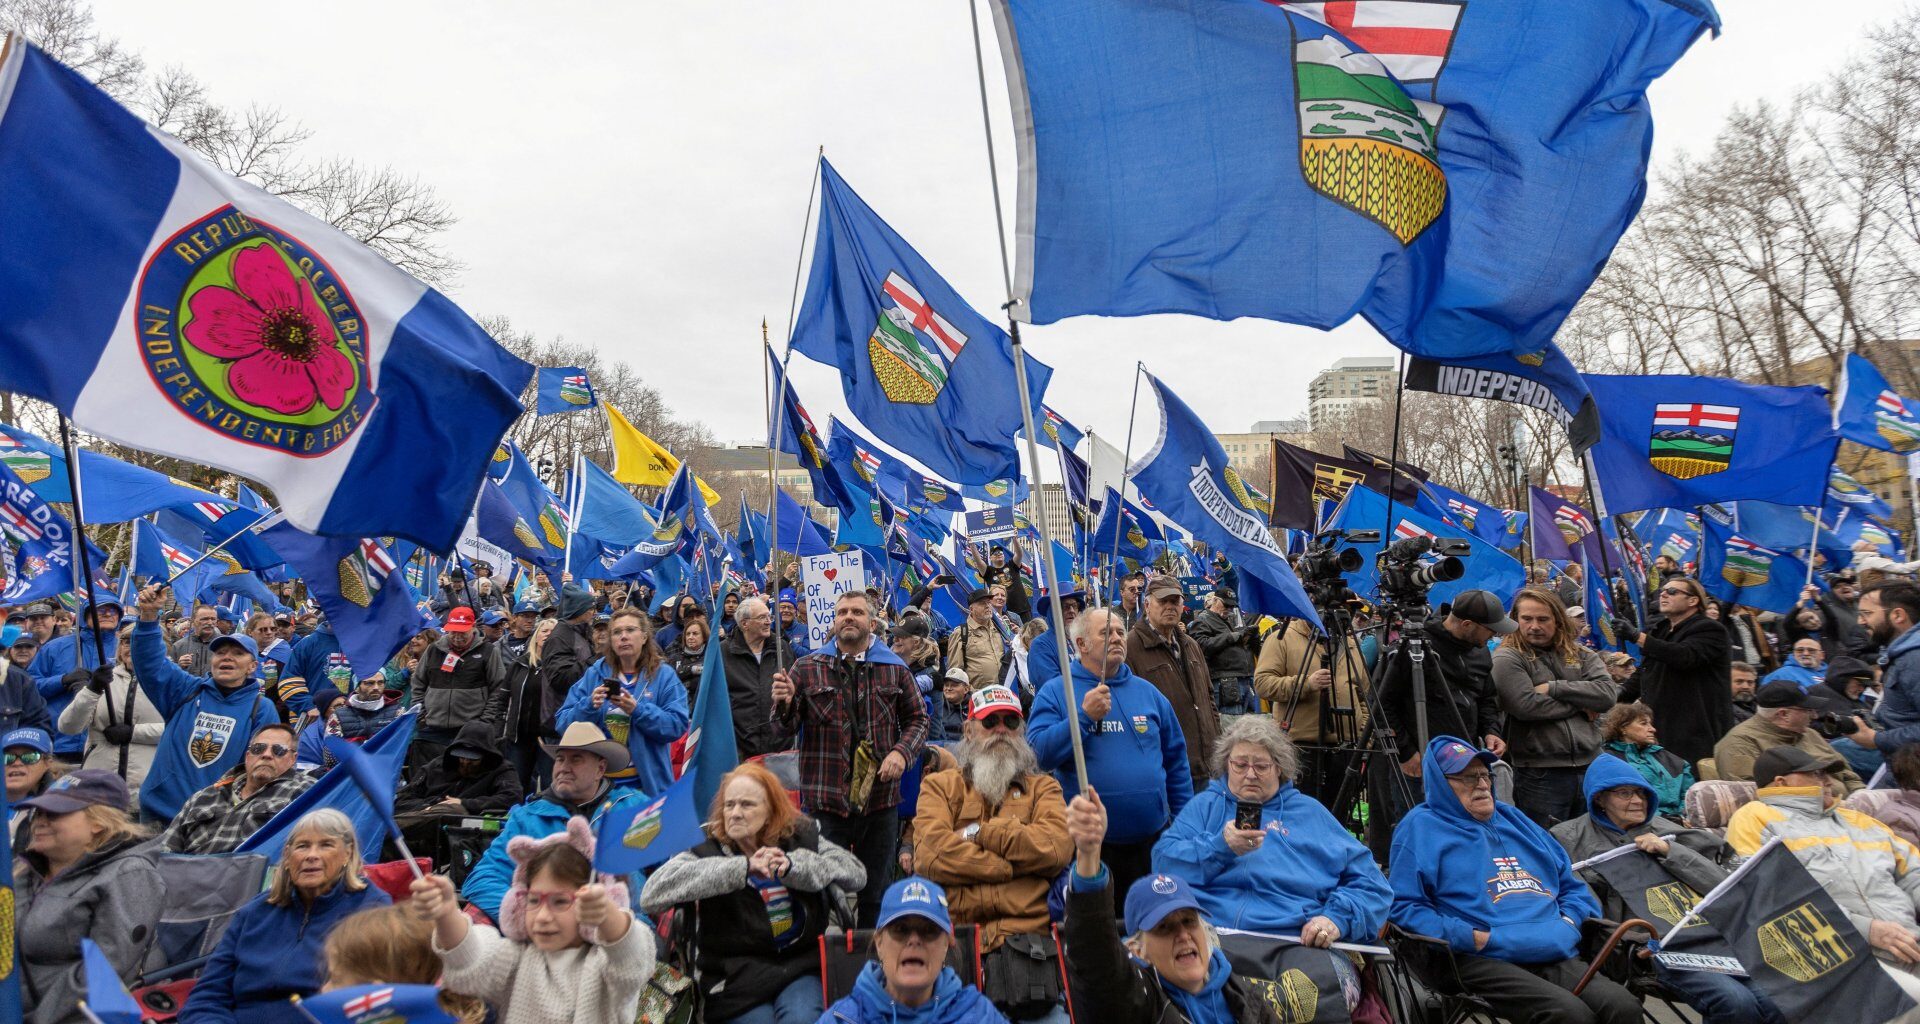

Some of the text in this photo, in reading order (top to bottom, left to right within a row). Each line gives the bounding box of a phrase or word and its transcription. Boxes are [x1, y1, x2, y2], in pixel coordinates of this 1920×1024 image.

[174, 210, 260, 265] REPUB
[144, 304, 363, 451] INDEPENDENT & FREE
[1437, 365, 1575, 435] INDEPENDENT
[648, 463, 664, 472] DON
[1193, 475, 1255, 539] INDEPENDENT
[31, 504, 70, 568] DONE
[969, 528, 991, 536] CHOOSE
[990, 524, 1015, 532] ALBERTA
[810, 552, 859, 572] For The
[833, 579, 853, 595] All
[809, 597, 836, 612] Albe
[813, 610, 836, 625] Vot
[811, 625, 831, 642] Opt
[195, 719, 231, 733] ALBERTA
[199, 714, 225, 724] REPUBLIC
[1088, 720, 1125, 733] LERTA
[1496, 879, 1544, 893] ALBERTA
[1660, 953, 1726, 968] FOREVER
